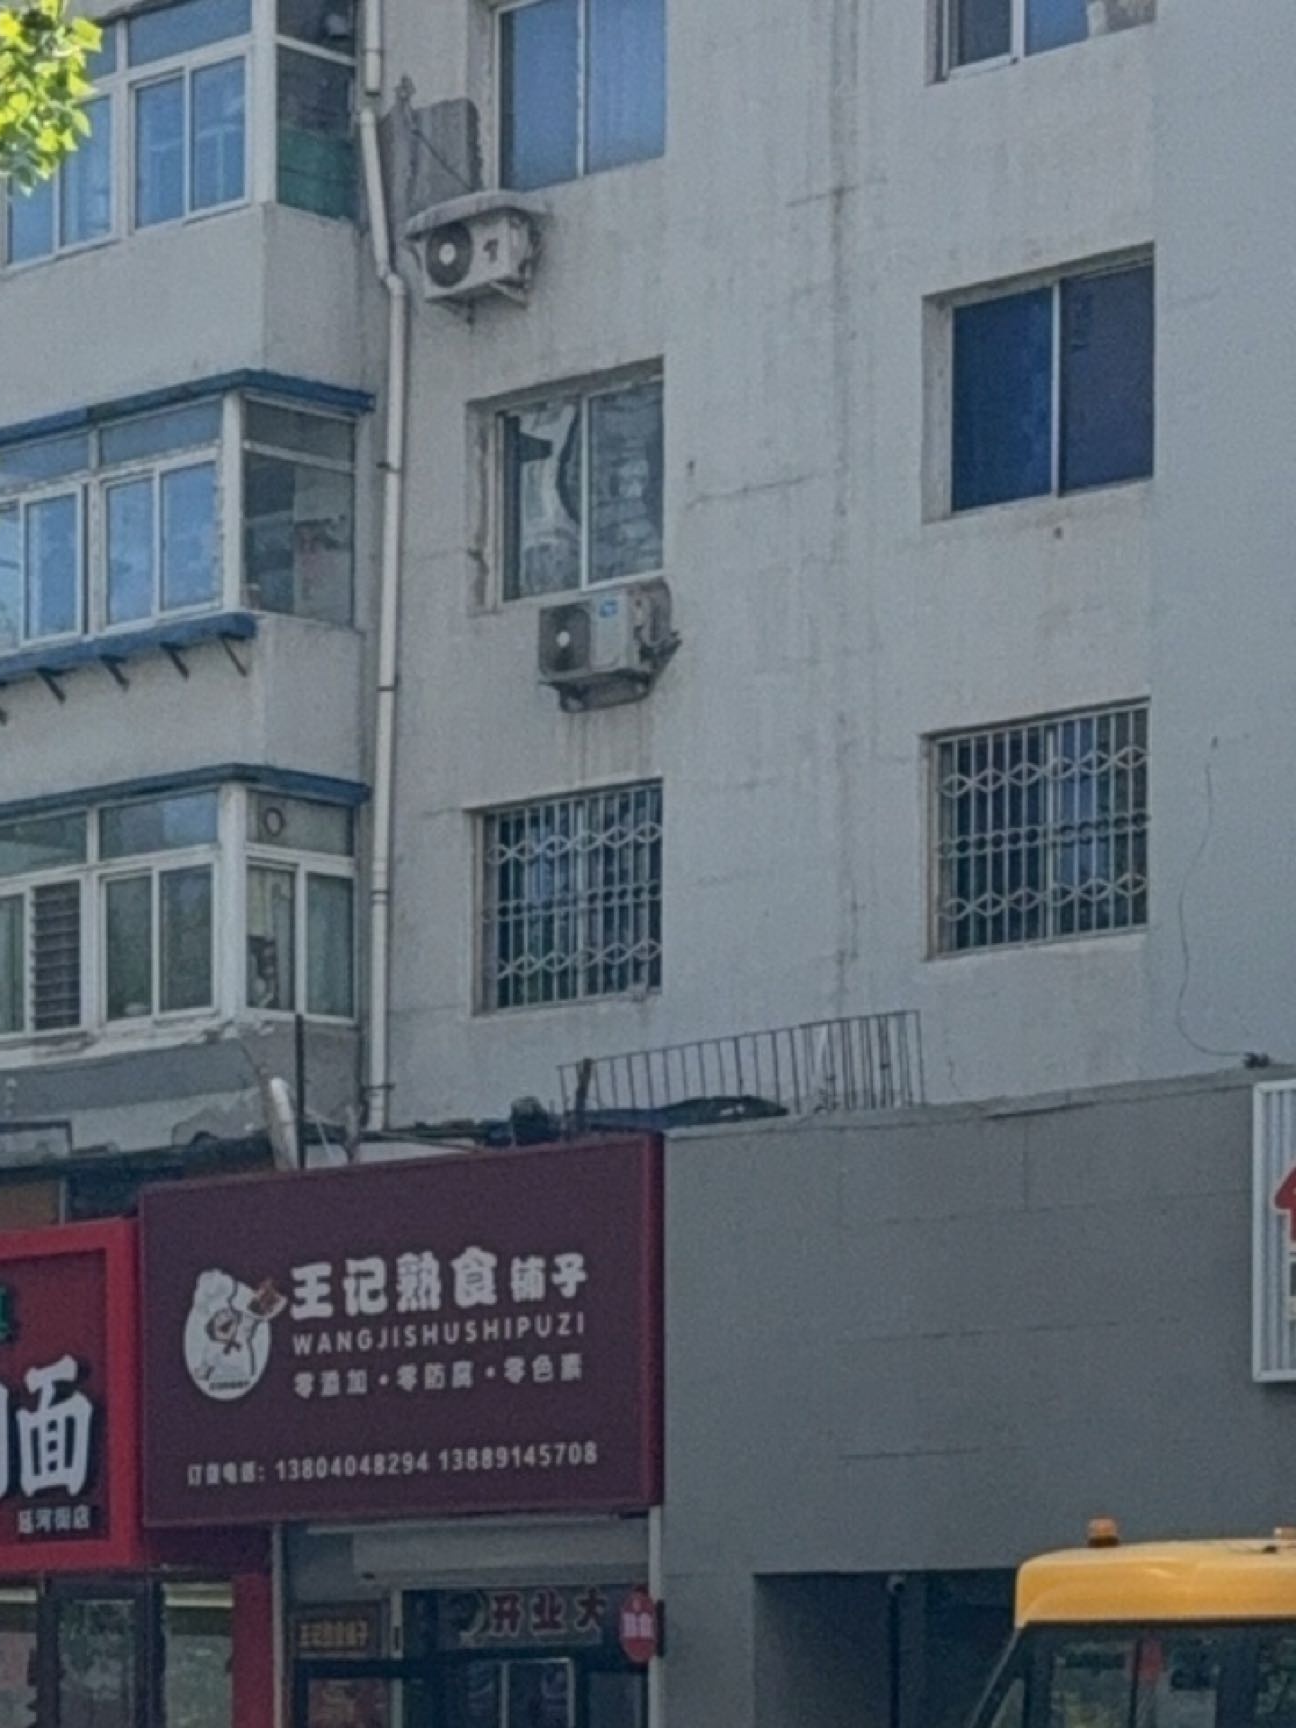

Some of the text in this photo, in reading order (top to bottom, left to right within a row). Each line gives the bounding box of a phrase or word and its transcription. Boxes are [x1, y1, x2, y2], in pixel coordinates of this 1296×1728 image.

[289, 1246, 590, 1322] 王记熟食铺子
[291, 1312, 587, 1357] WANGJISHUSHIPUZI
[274, 1446, 430, 1484] 13804048294
[437, 1440, 599, 1475] 13889145708
